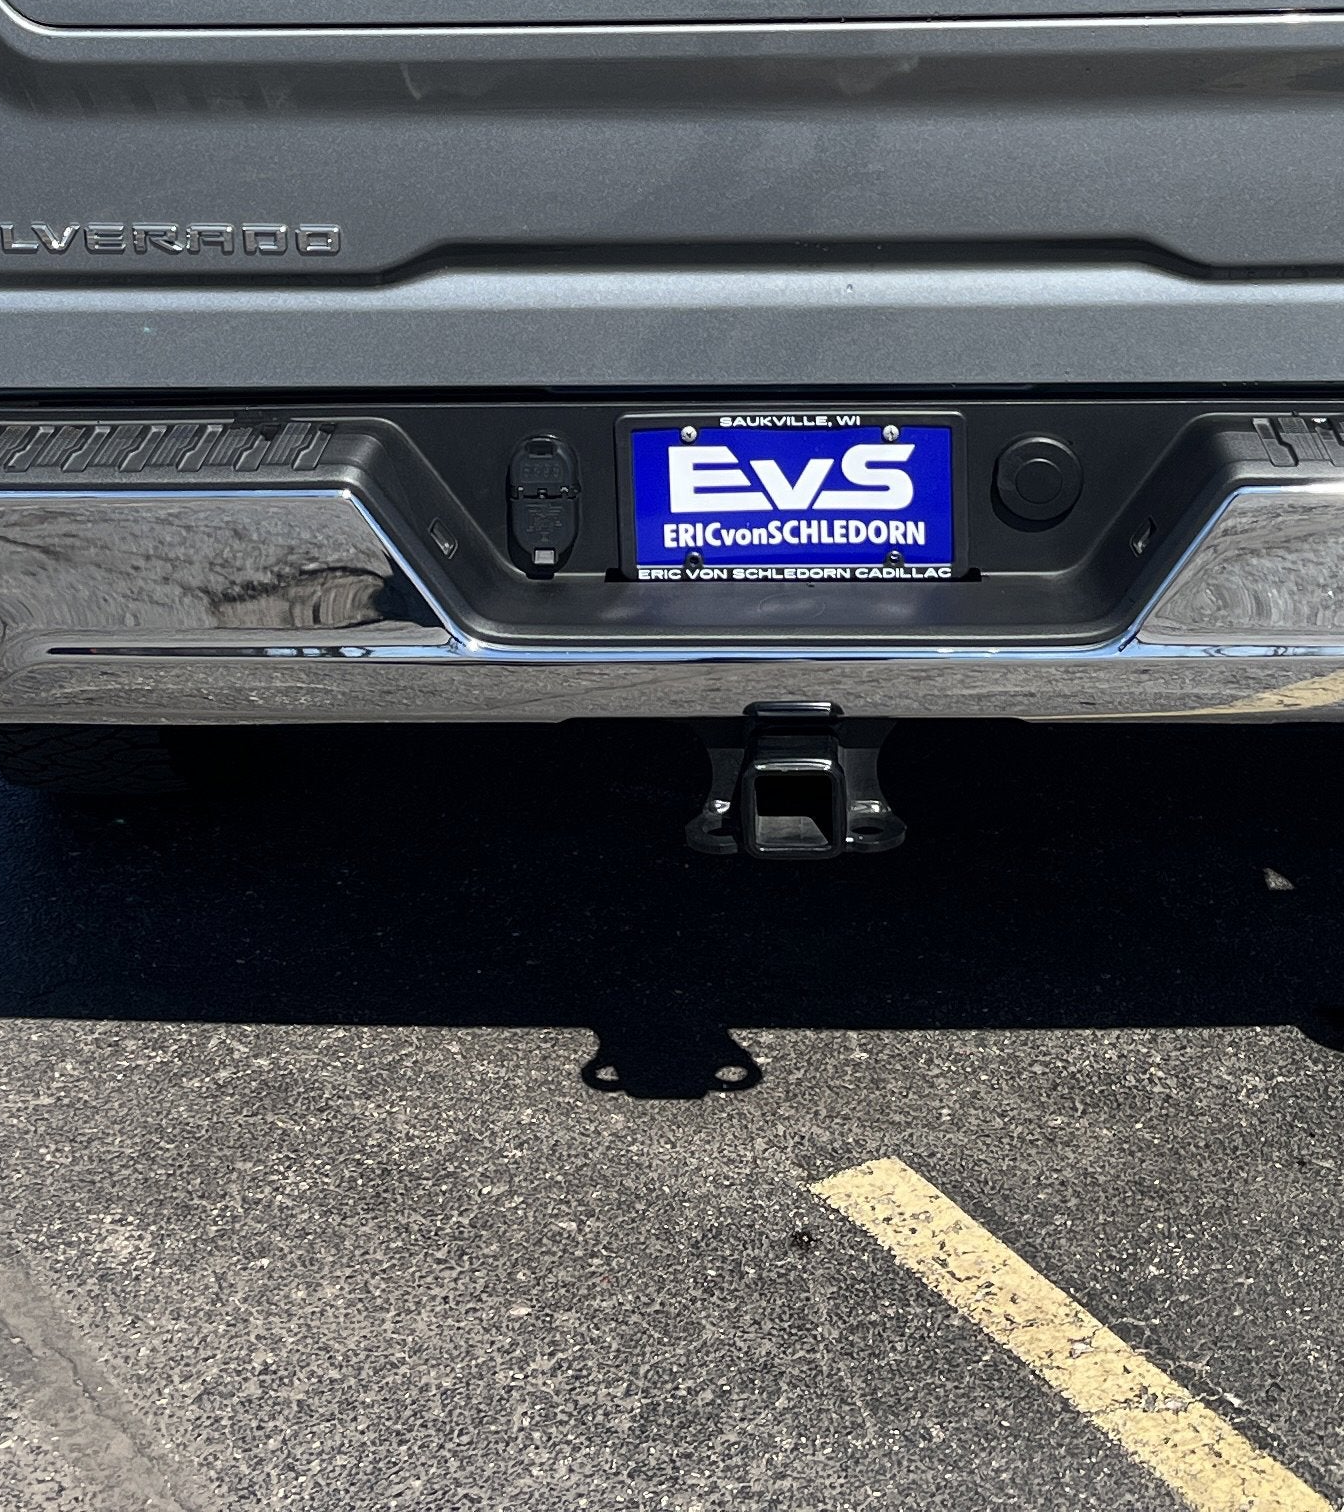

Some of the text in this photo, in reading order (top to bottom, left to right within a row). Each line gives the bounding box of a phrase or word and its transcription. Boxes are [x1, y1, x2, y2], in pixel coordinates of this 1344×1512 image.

[719, 415, 861, 428] SAUKVILLE, WI
[638, 567, 952, 580] ERIC VON SCHLEDORN CADILLAC
